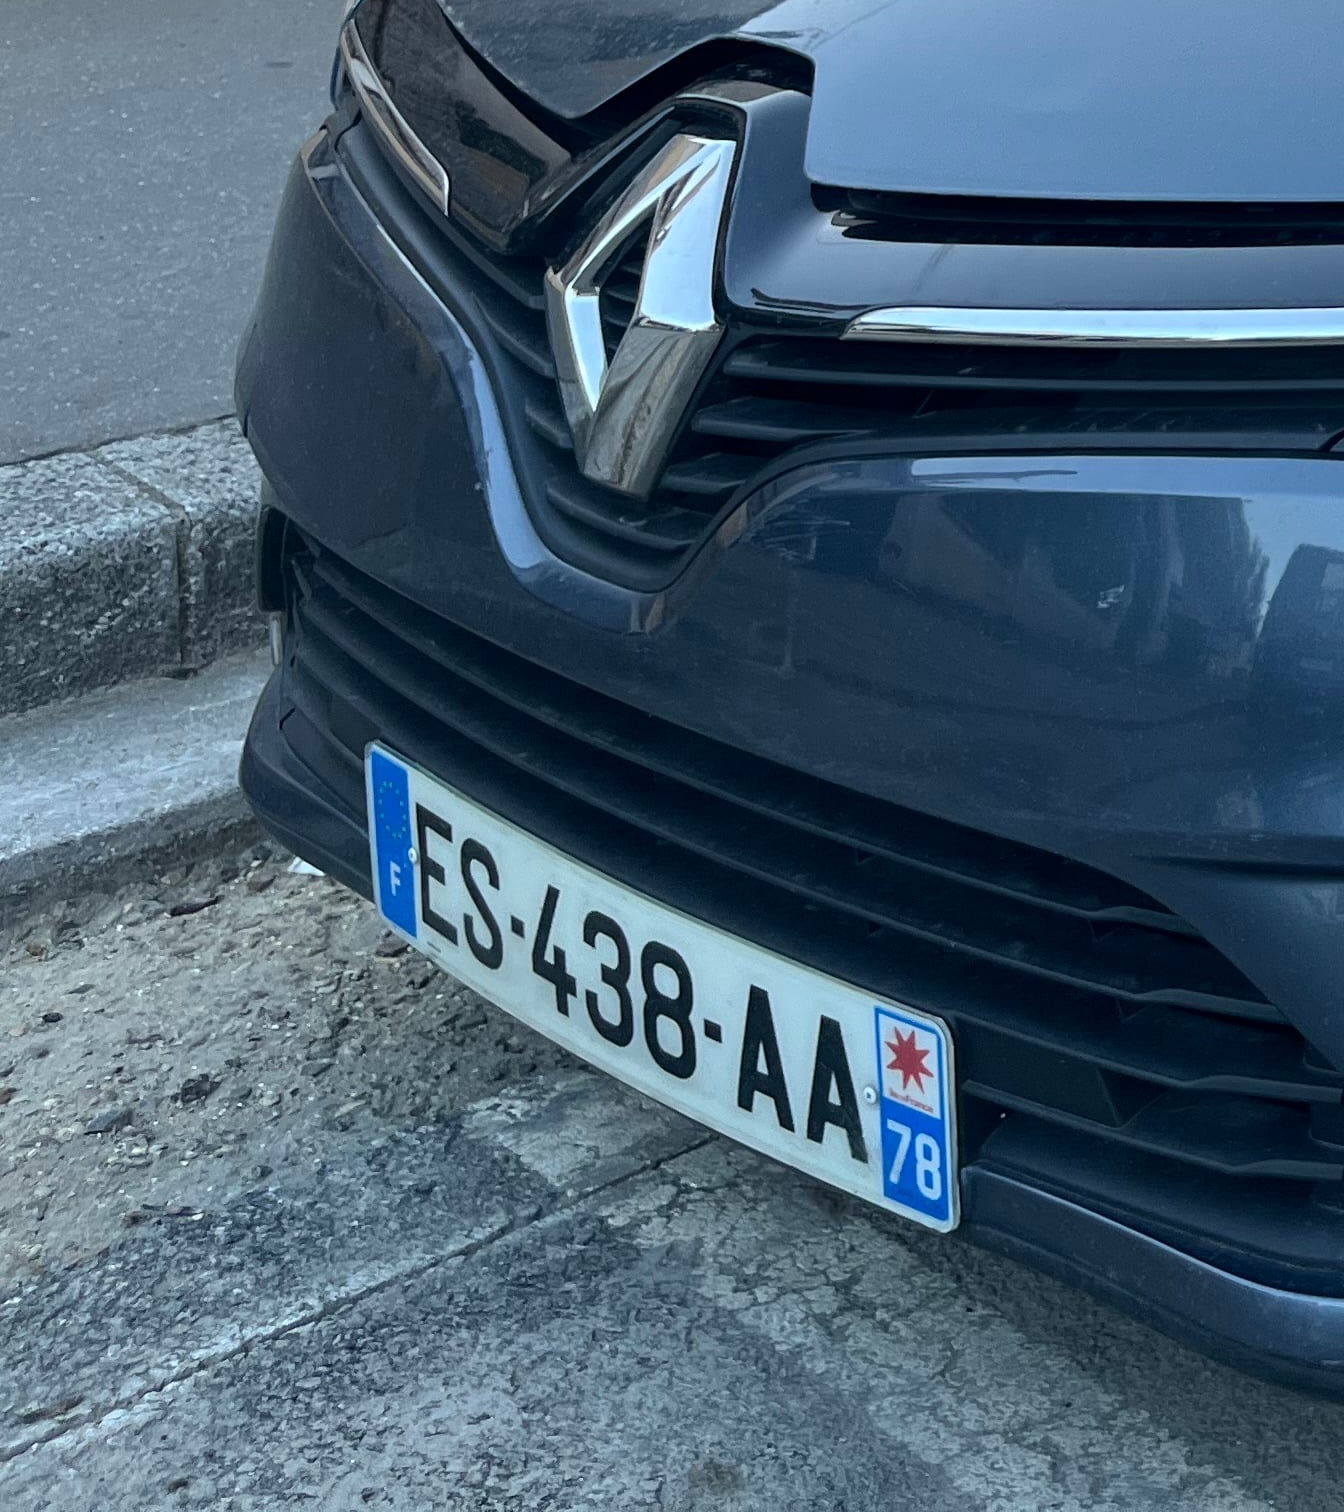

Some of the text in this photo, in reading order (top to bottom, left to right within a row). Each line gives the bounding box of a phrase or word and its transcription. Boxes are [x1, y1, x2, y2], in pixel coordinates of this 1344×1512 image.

[389, 860, 401, 897] F
[415, 802, 868, 1163] ES-438-AA
[886, 1118, 942, 1200] 78
